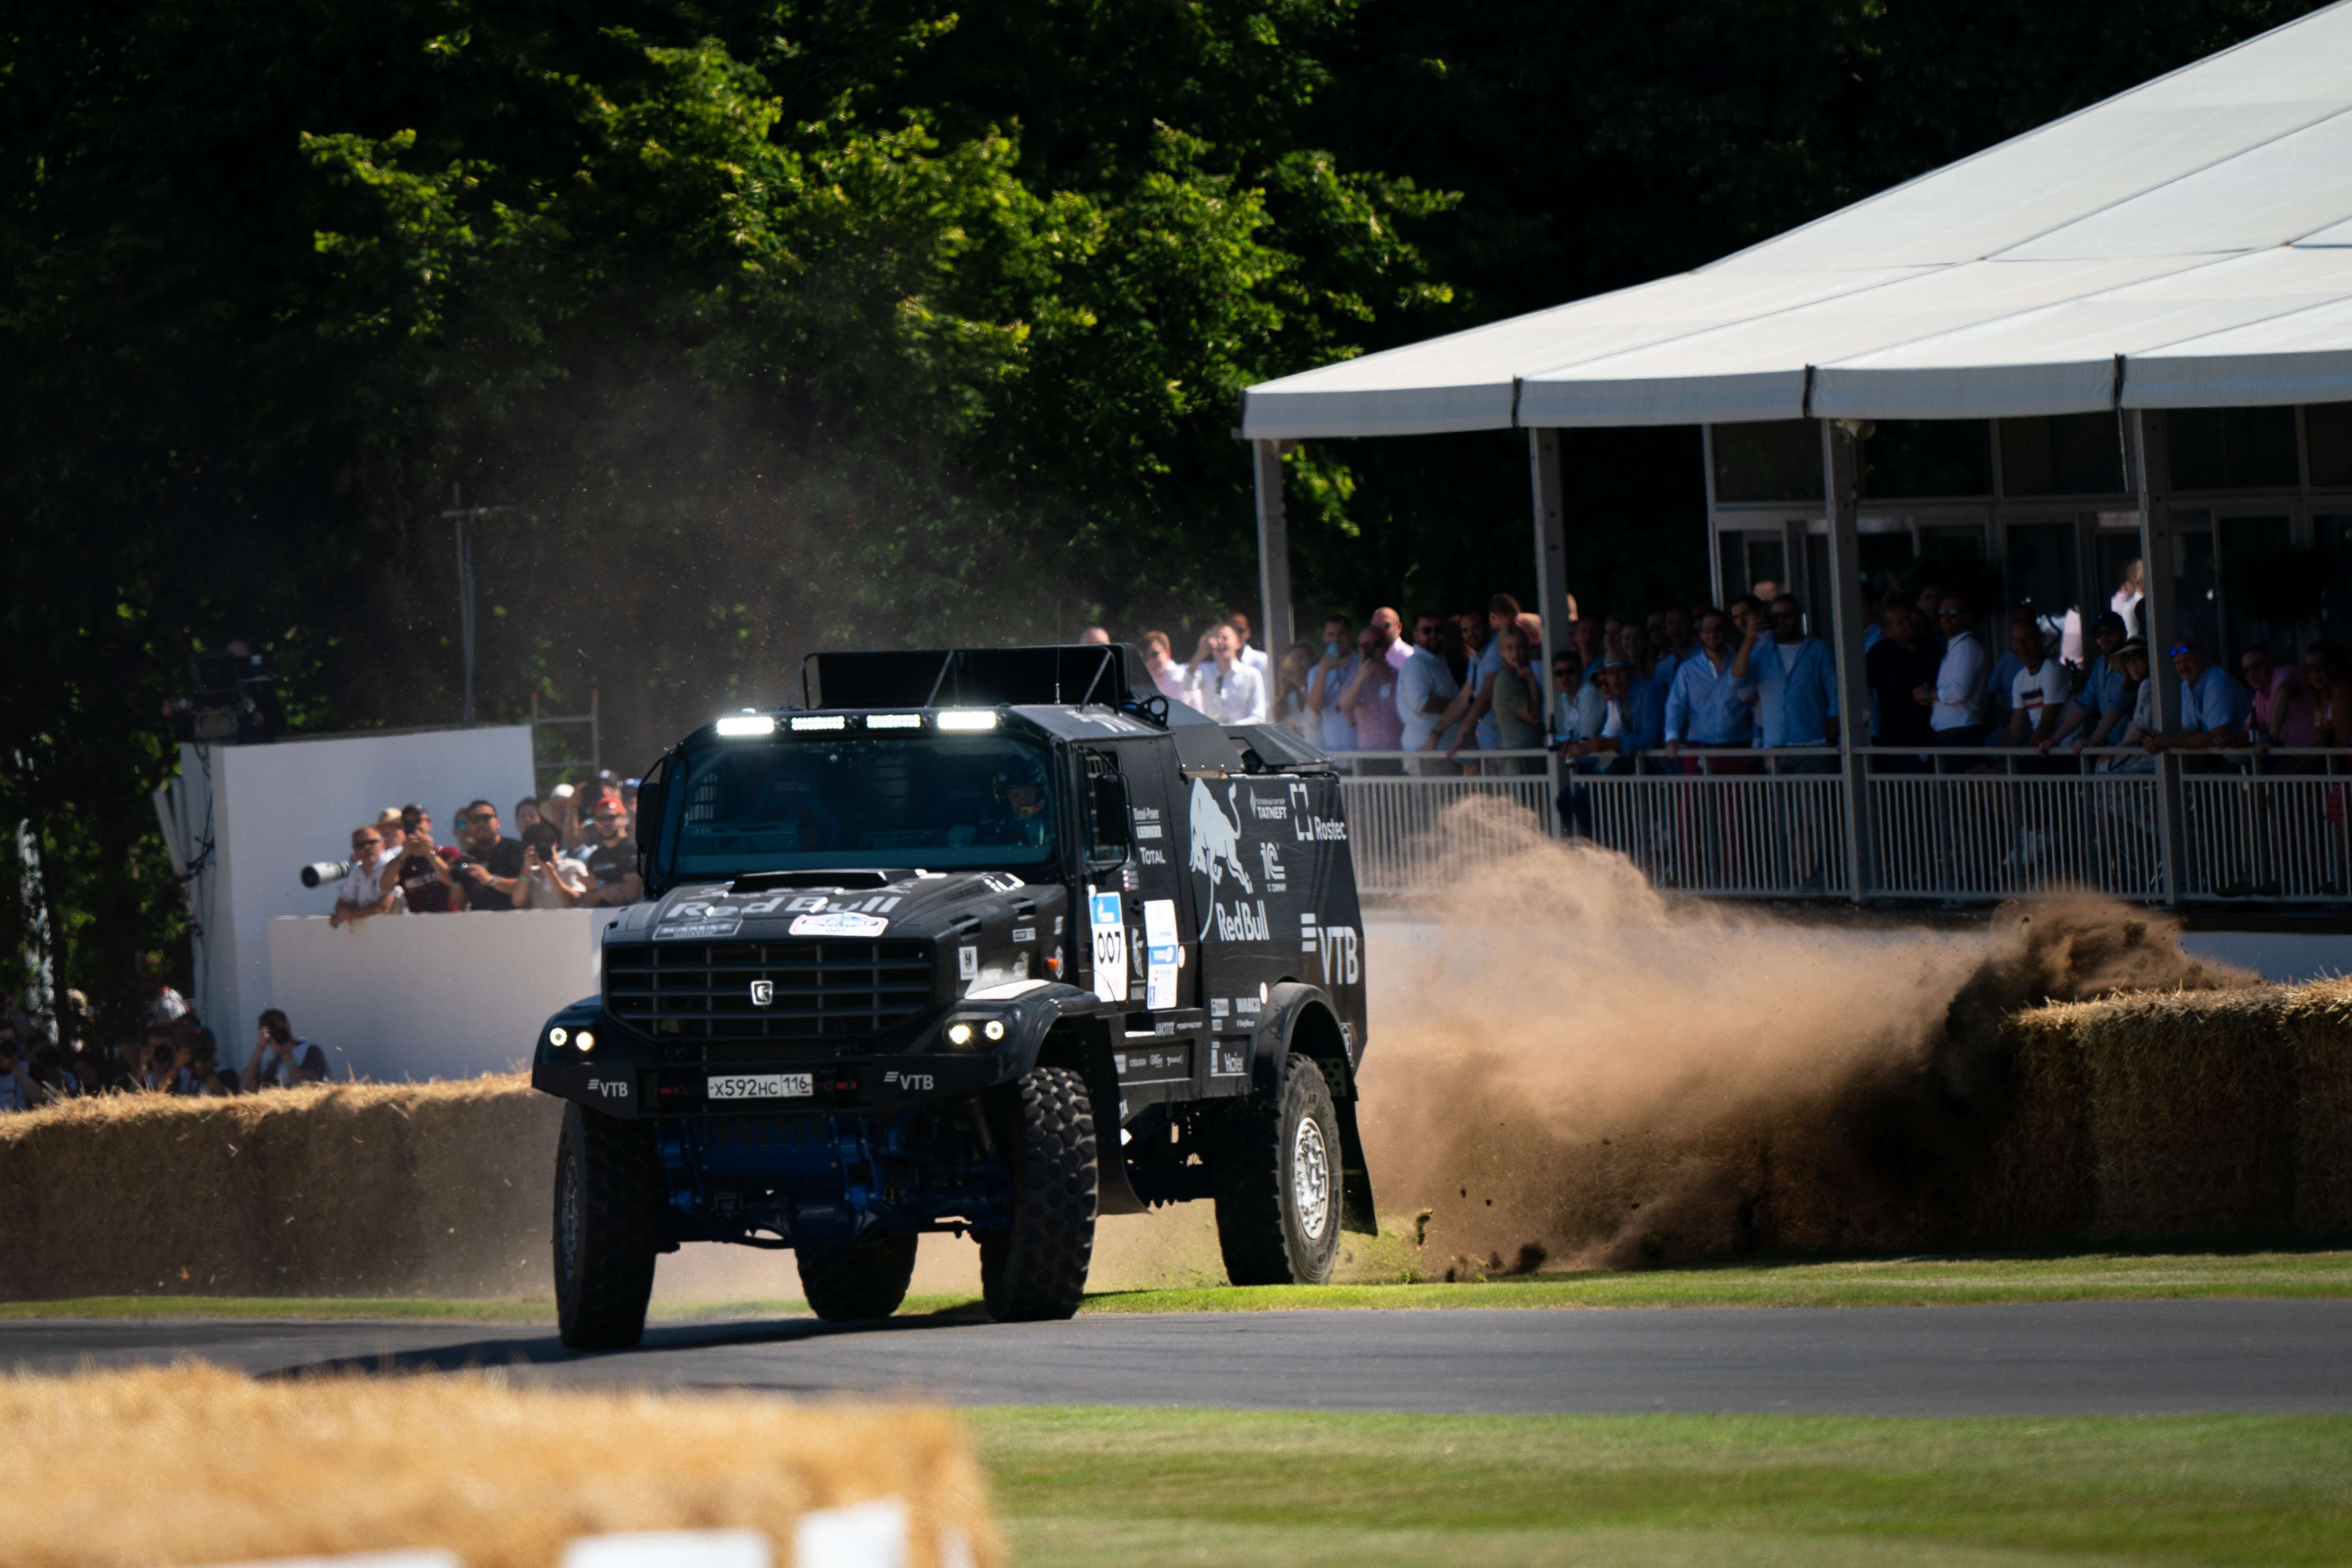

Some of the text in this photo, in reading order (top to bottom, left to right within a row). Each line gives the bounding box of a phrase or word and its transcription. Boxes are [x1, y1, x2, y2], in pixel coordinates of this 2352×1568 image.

[1257, 806, 1287, 819] TATNEFT
[1314, 816, 1347, 840] Rostec
[666, 896, 902, 918] Red Bull
[1216, 900, 1270, 941] Red Bull
[1097, 931, 1121, 964] 007
[1317, 926, 1359, 985] VTB
[1224, 1052, 1243, 1072] Haier
[599, 1082, 628, 1098] VTB
[783, 1077, 807, 1090] 116
[900, 1074, 934, 1090] VTB
